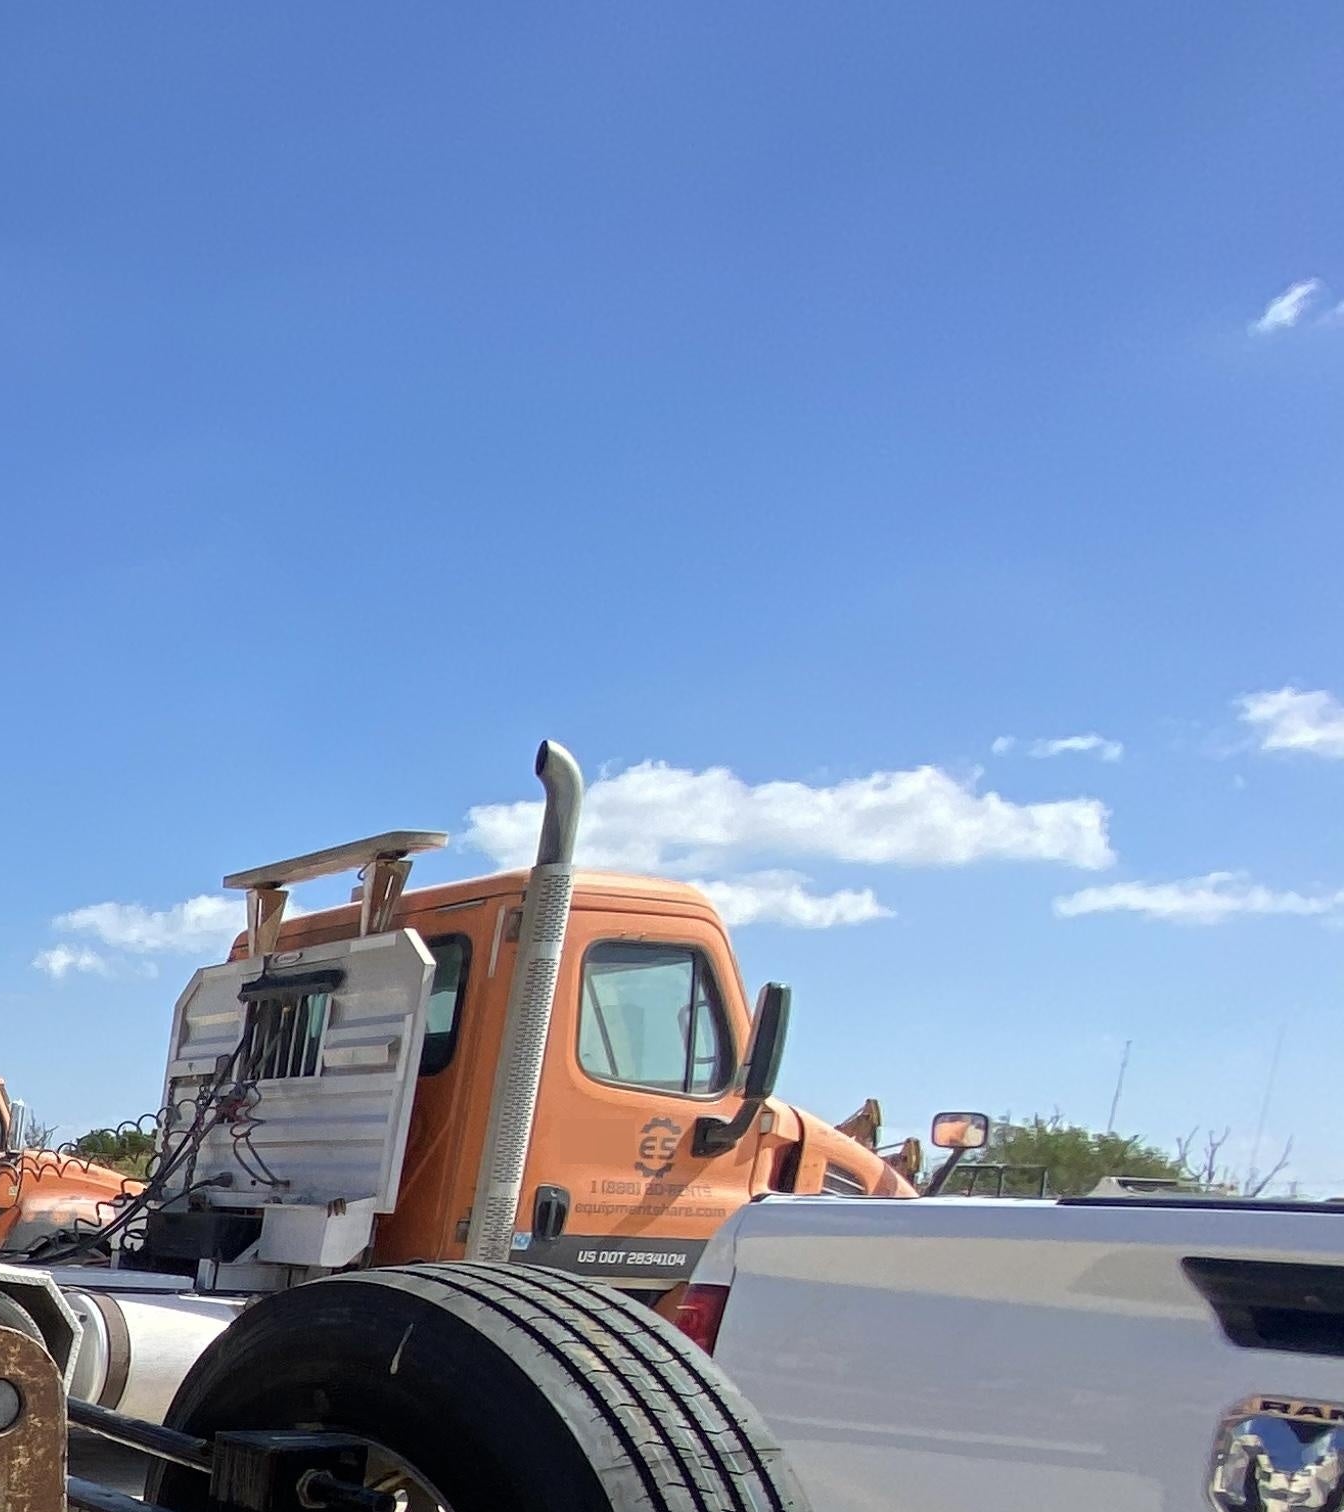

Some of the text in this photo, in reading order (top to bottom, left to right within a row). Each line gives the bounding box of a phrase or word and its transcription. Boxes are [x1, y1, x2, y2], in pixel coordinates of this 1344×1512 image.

[574, 1202, 727, 1217] equipmentshare.com
[577, 1250, 687, 1266] US DOT 2834104
